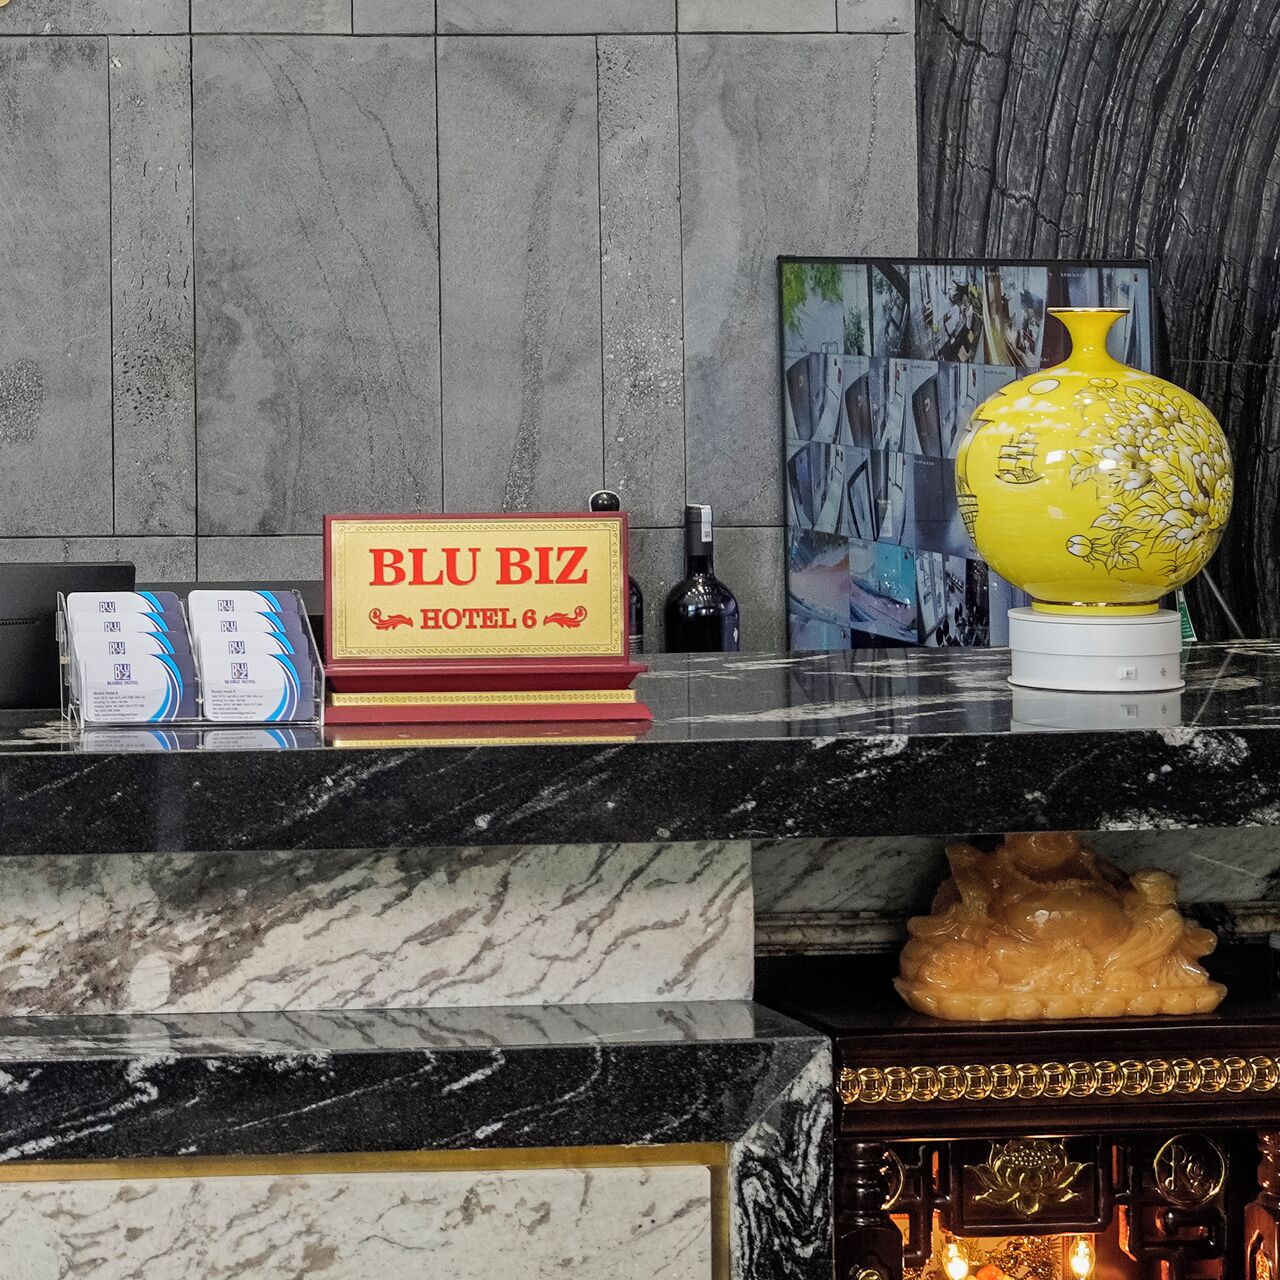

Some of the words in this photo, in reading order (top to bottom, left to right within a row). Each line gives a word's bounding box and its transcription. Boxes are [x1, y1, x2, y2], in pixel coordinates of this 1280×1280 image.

[369, 547, 481, 586] BLU
[495, 546, 588, 585] BIZ
[420, 608, 517, 630] HOTEL
[522, 609, 538, 630] 6
